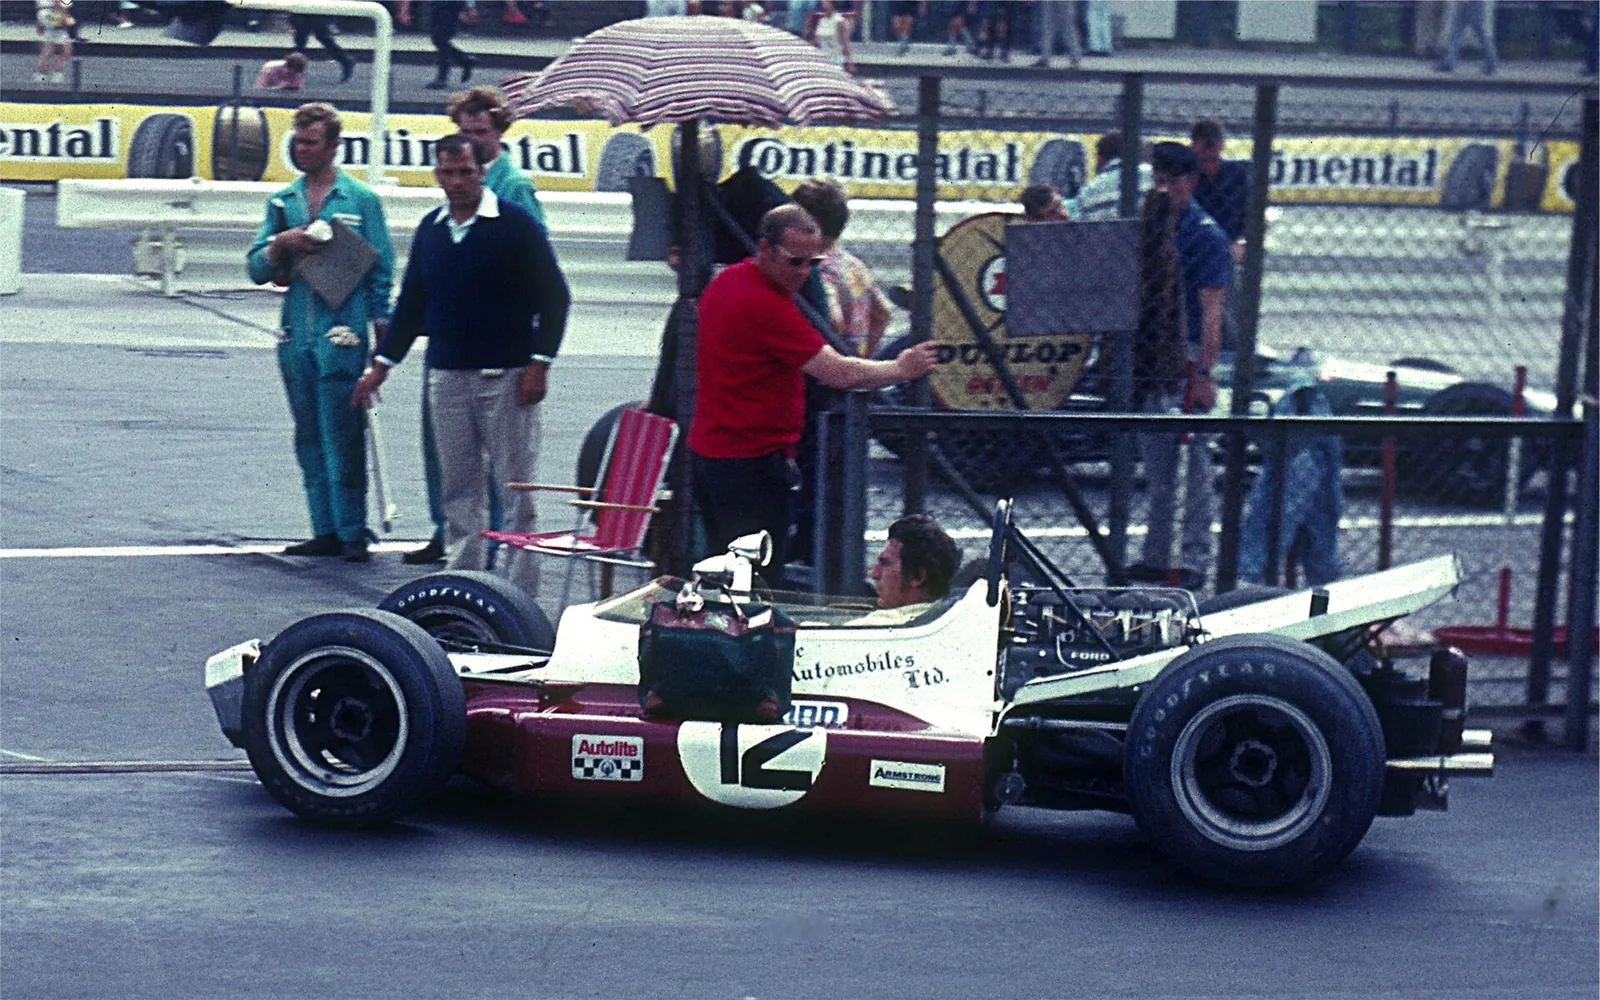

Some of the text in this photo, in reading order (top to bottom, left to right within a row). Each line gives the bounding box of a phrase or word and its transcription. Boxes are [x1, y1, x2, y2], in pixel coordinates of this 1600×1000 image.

[397, 587, 496, 614] GOODYEAR
[1070, 651, 1110, 661] FORD
[577, 739, 638, 757] Autolite
[720, 720, 813, 792] 12
